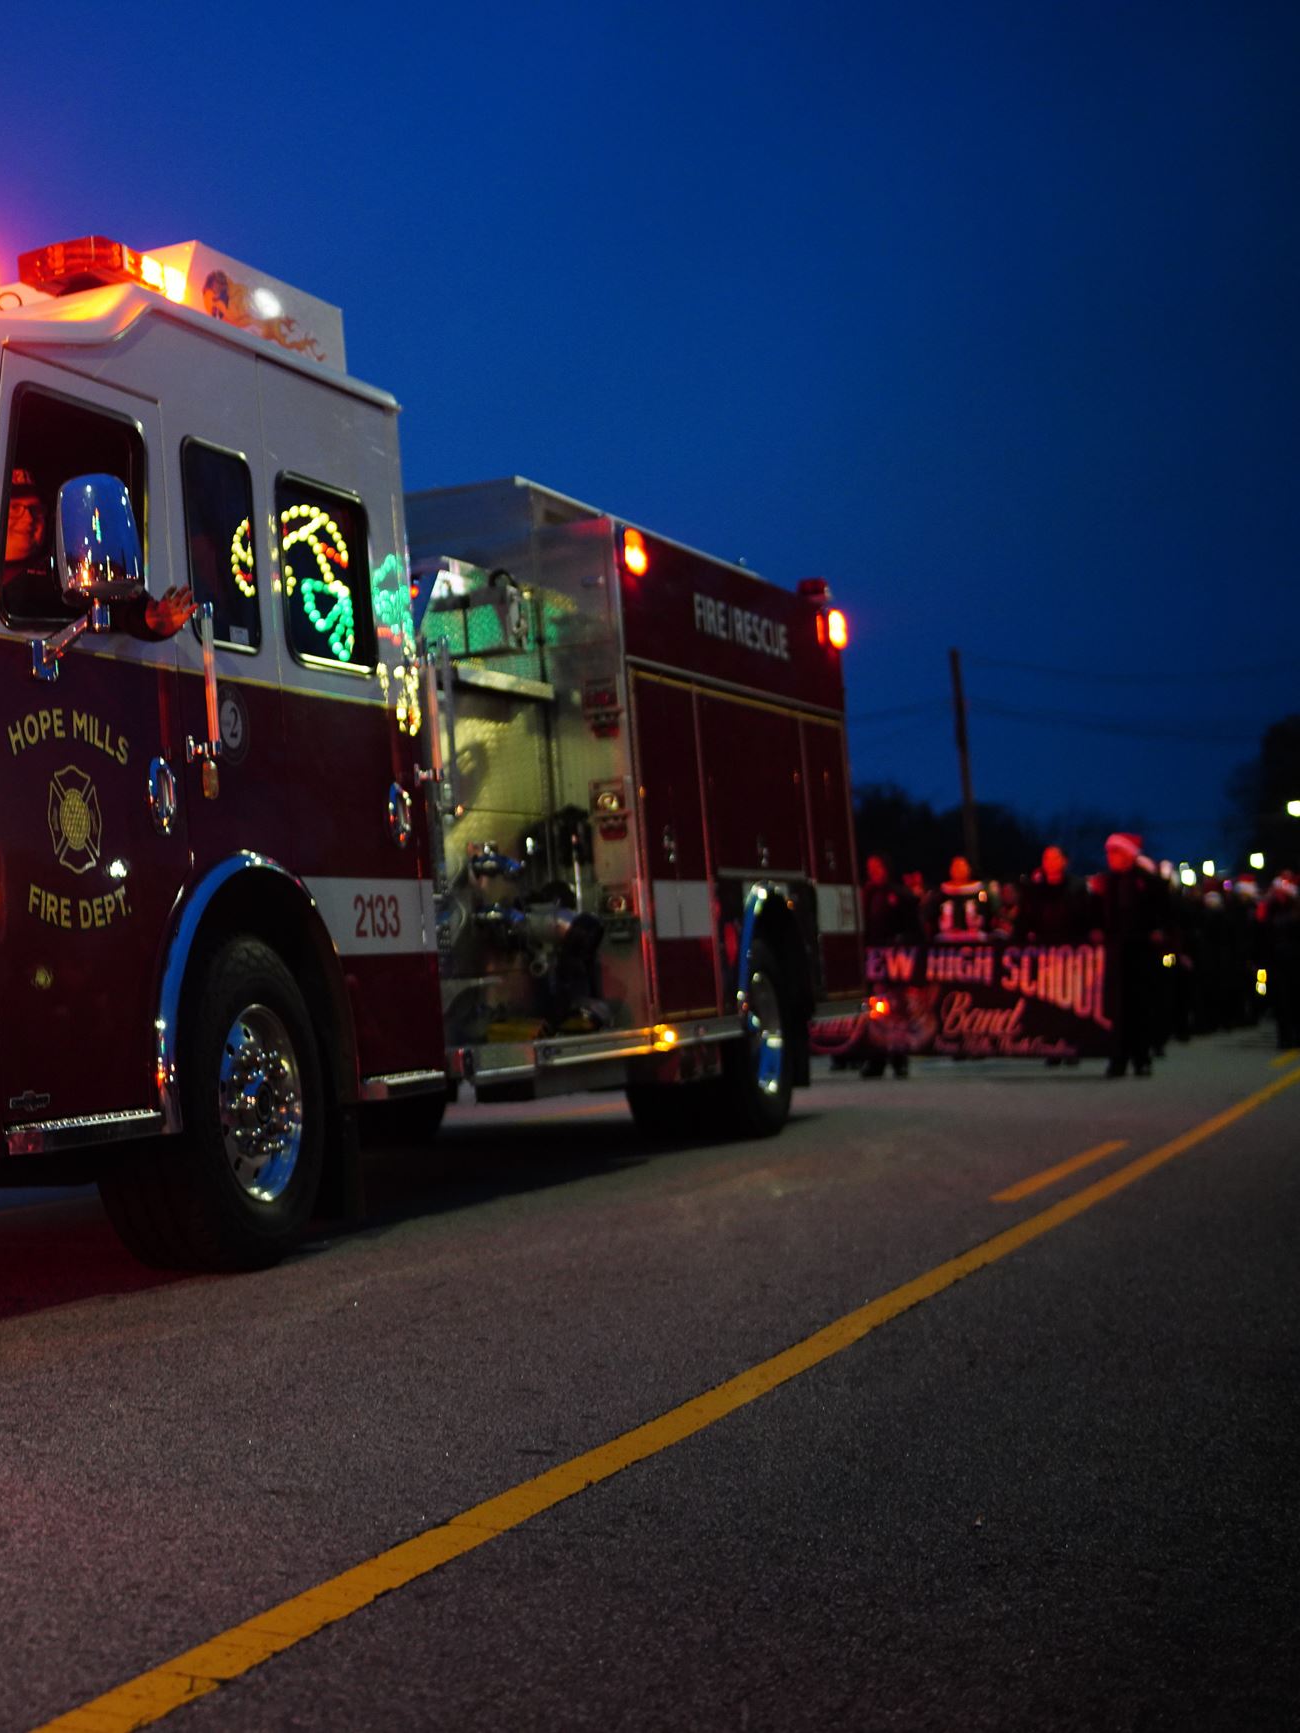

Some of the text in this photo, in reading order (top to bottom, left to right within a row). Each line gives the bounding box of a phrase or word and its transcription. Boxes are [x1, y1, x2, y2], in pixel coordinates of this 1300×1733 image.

[7, 707, 130, 766] HOPE MILLS
[28, 882, 132, 930] FIRE DEPT.
[353, 894, 401, 938] 2133
[925, 946, 995, 986] HIGH
[1000, 943, 1115, 1032] SCHOOL
[940, 990, 1026, 1038] Band
